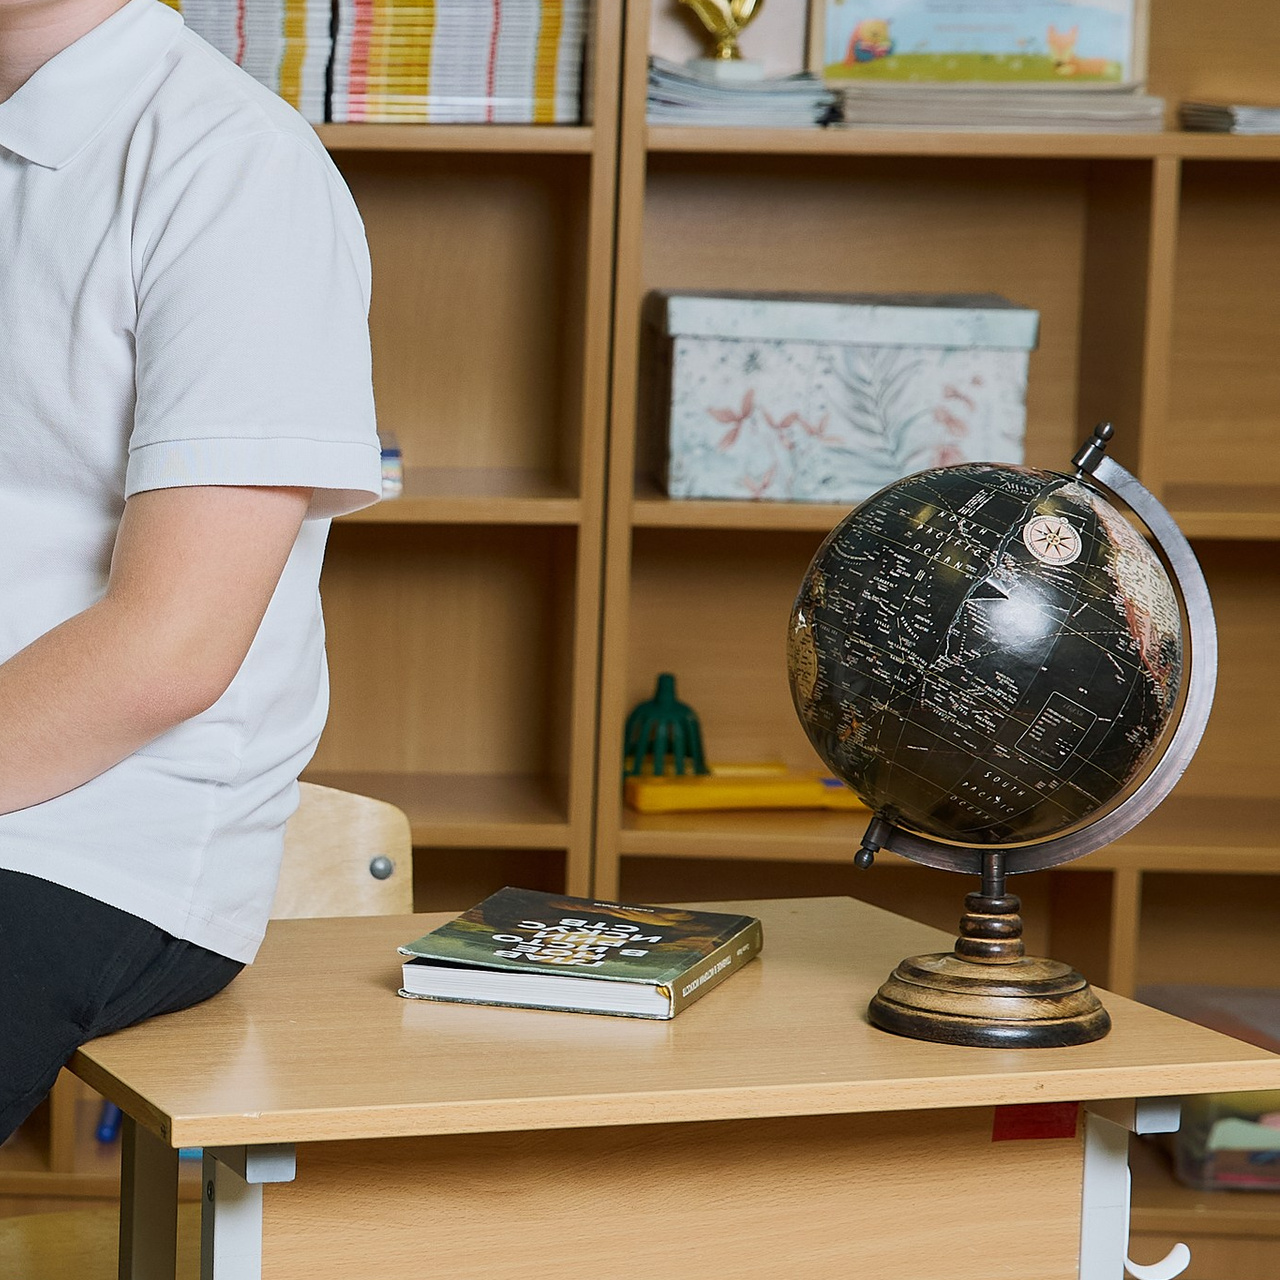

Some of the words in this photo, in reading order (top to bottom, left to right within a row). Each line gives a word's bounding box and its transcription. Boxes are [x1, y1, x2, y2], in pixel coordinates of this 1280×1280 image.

[938, 511, 988, 535] NORTH
[916, 524, 982, 557] PACIFIC
[913, 543, 963, 569] OCEAN
[984, 771, 1026, 797] SOUTH
[950, 795, 990, 819] OCEAN
[962, 781, 1014, 813] PACIFIC
[517, 920, 663, 943] ИСКУС
[559, 918, 640, 933] СТВ
[492, 934, 609, 953] ИСТО
[533, 931, 627, 948] РИИ
[493, 949, 605, 967] ГЛАВ
[512, 944, 606, 960] НОЕ
[619, 949, 649, 957] В
